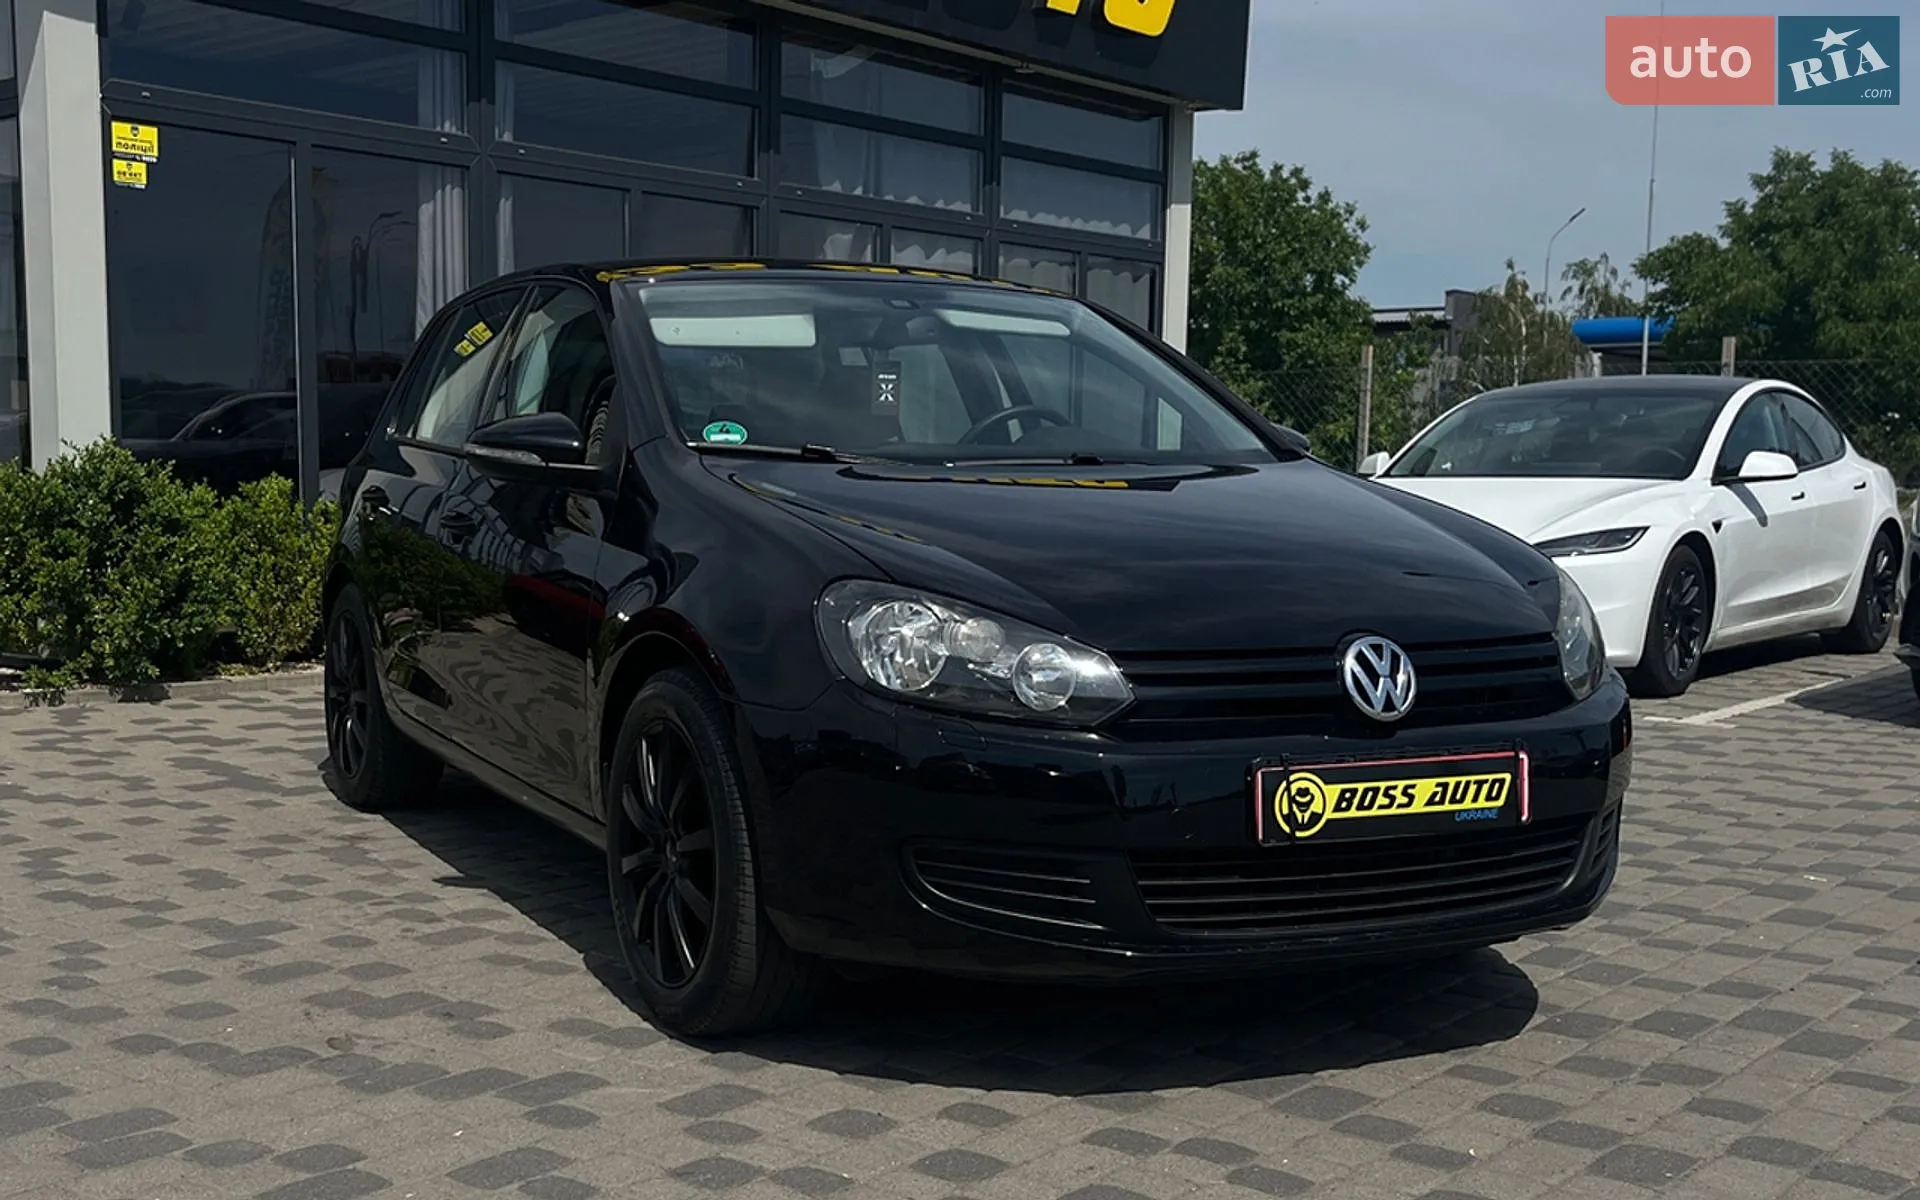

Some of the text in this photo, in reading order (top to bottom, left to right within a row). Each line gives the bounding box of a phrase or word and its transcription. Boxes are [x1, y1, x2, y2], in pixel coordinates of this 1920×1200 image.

[1332, 778, 1506, 813] BOSS AUTO
[1455, 808, 1499, 822] UKRAINE
